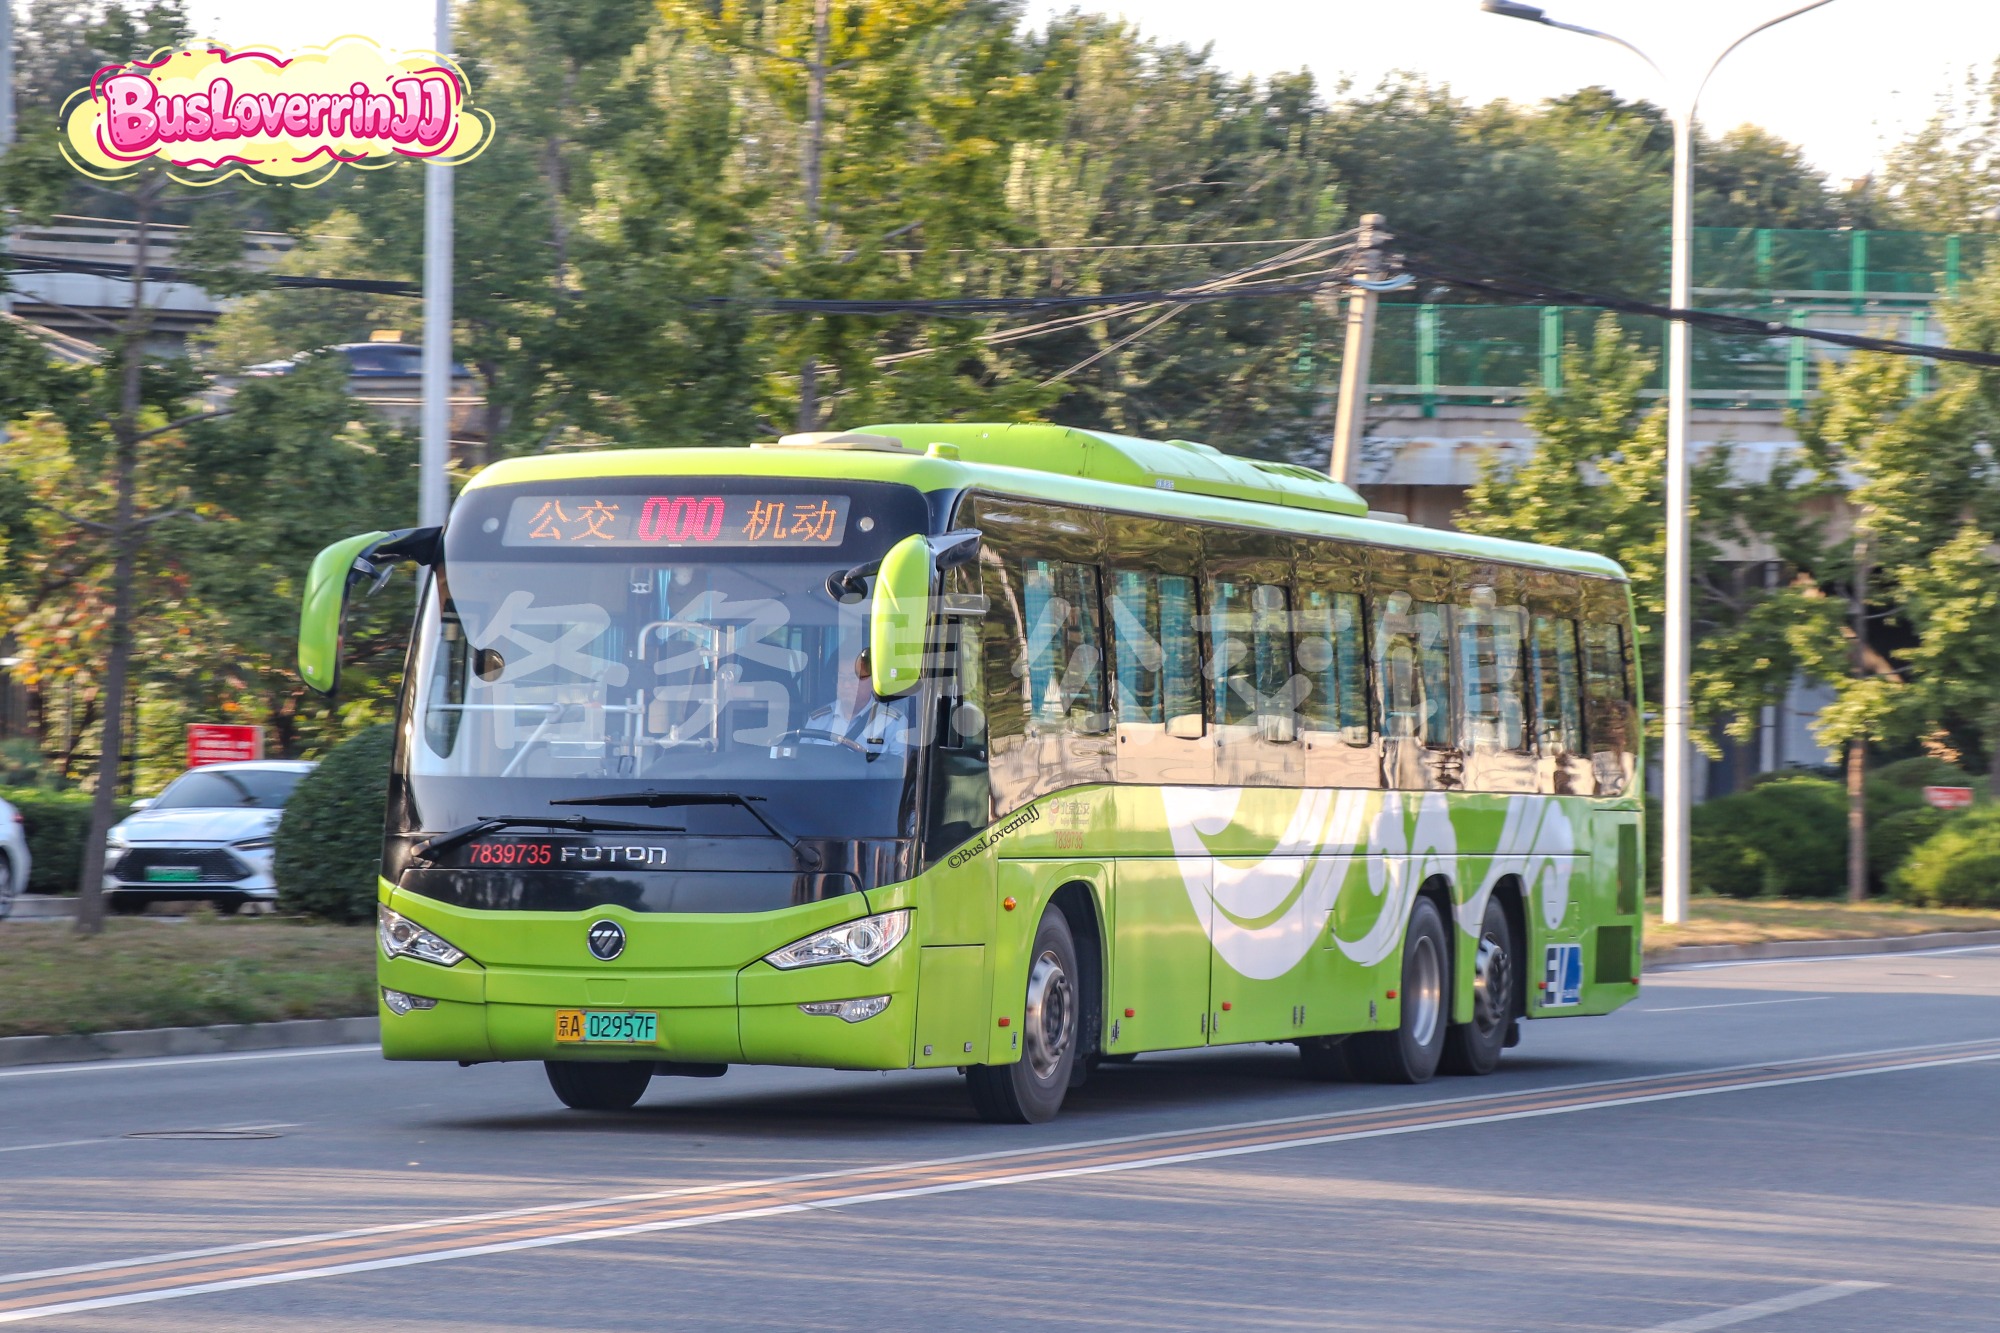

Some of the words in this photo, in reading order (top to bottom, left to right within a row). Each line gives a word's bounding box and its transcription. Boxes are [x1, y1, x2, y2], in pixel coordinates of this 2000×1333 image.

[528, 500, 620, 541] 公交
[638, 496, 725, 541] 000
[741, 500, 837, 542] 机动
[469, 844, 551, 865] 7839735
[560, 845, 668, 865] FOTON
